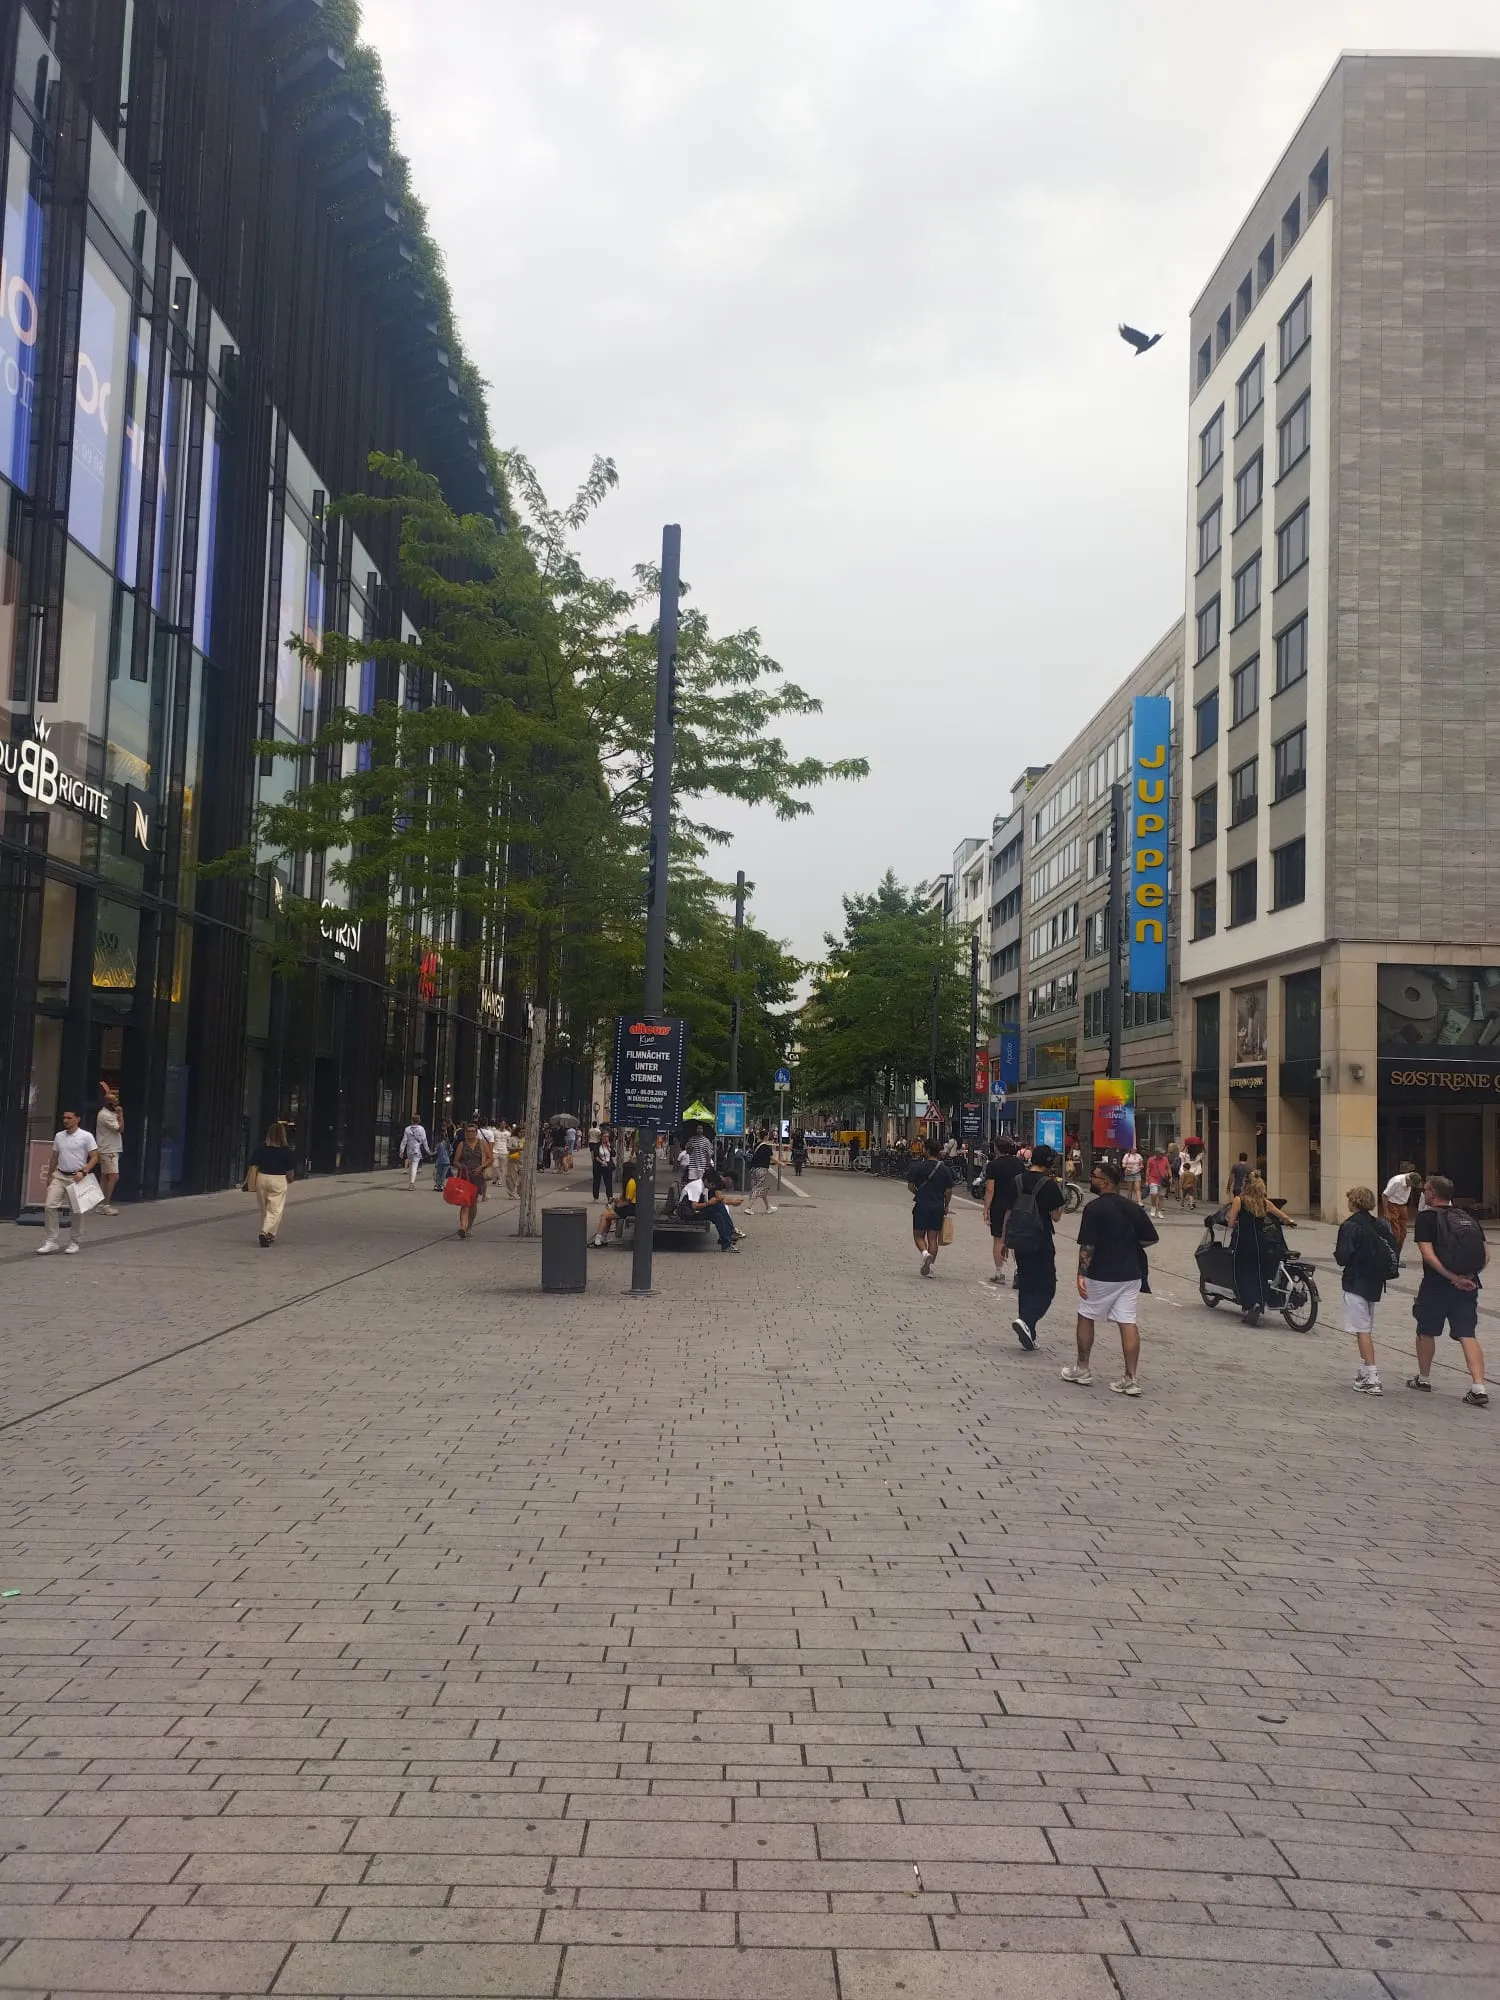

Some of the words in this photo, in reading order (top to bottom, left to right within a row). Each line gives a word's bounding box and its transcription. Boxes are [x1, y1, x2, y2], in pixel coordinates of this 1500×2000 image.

[0, 740, 18, 774] U
[480, 986, 505, 1021] MANGO
[640, 1034, 656, 1044] Kino
[626, 1050, 671, 1061] FILMNÄCHTE
[635, 1062, 659, 1071] UNTER
[630, 1073, 663, 1083] STERNEN
[1391, 1070, 1490, 1091] SØSTRENE
[632, 1094, 664, 1103] DÜSSELDORF
